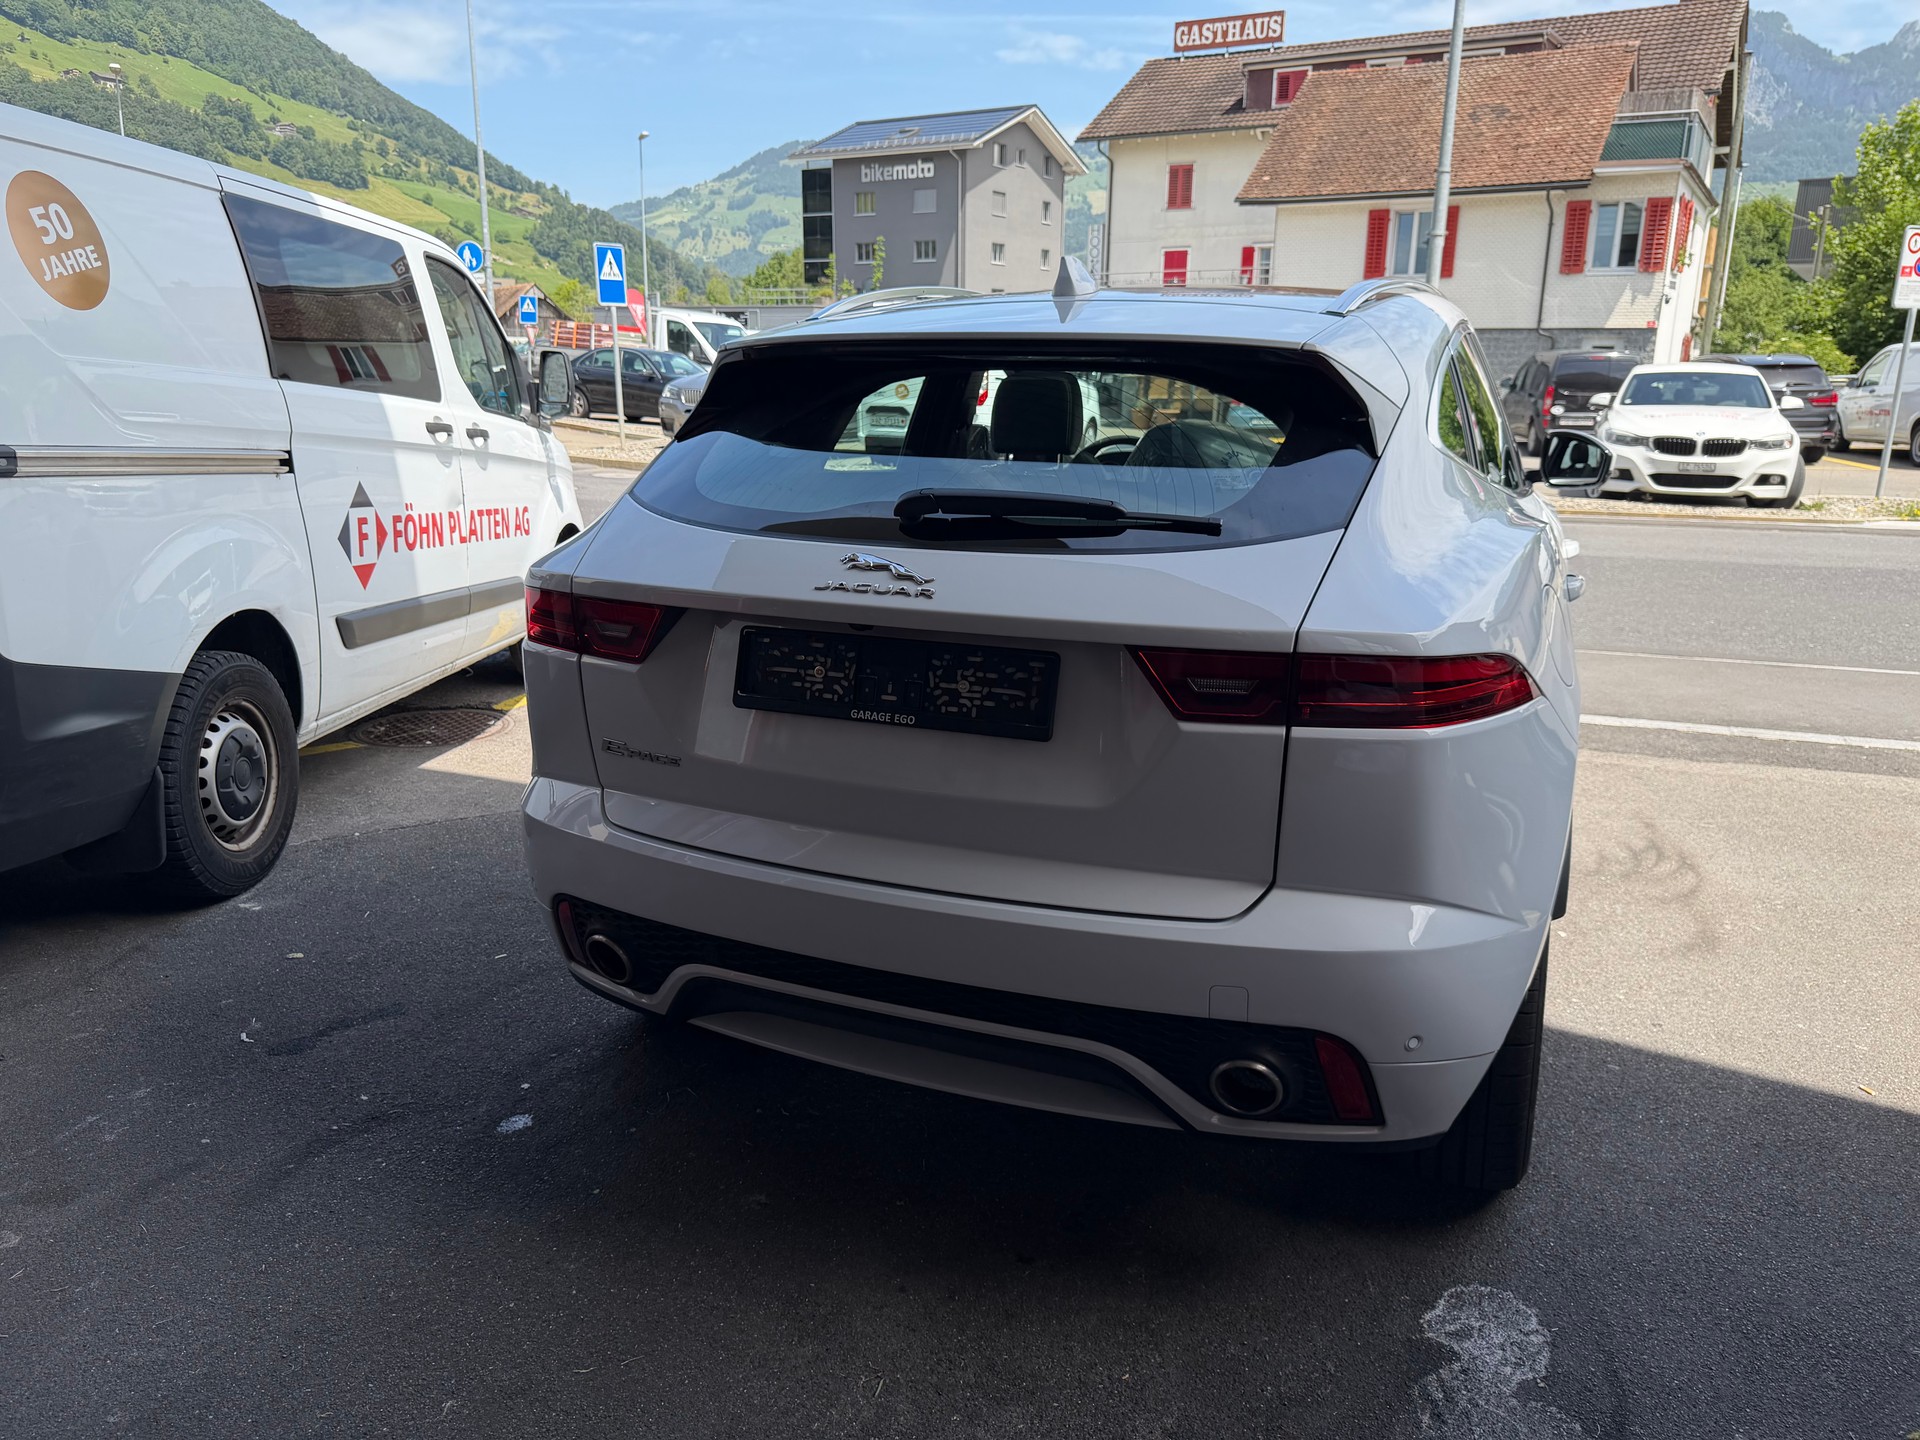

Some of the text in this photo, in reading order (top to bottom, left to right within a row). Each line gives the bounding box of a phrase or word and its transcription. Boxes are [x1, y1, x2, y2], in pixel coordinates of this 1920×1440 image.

[1175, 15, 1282, 47] GASTHAUS
[861, 159, 935, 183] bikemoto
[28, 202, 74, 245] 50
[40, 245, 102, 282] JAHRE
[357, 517, 369, 557] F
[392, 502, 531, 553] FÖHN PLATTEN AG
[814, 580, 936, 599] JAGUAR
[850, 709, 916, 725] GARAGE EGO
